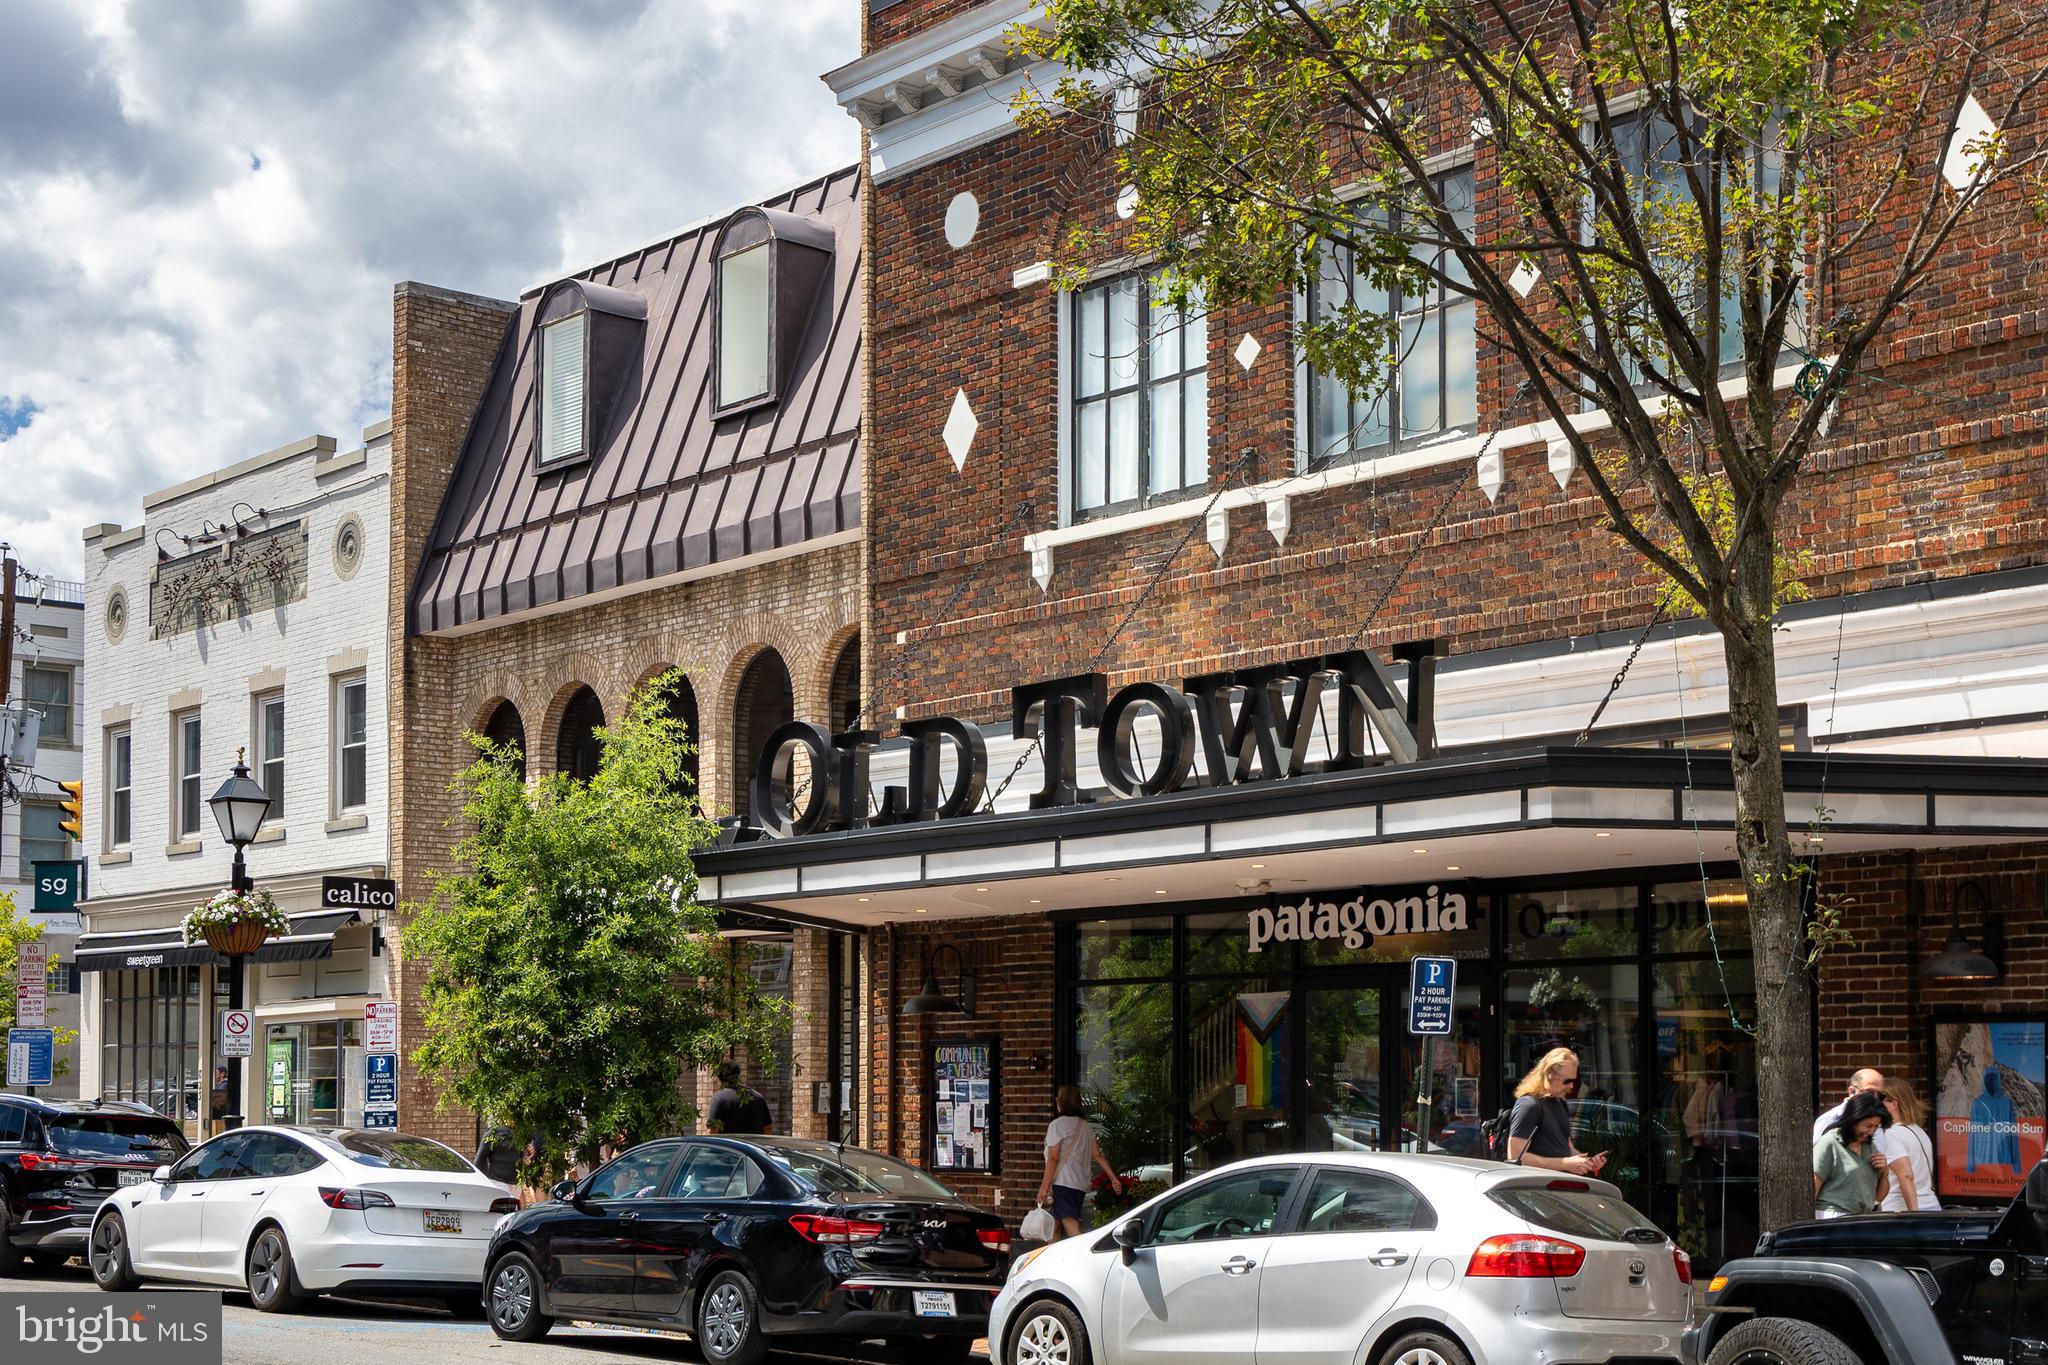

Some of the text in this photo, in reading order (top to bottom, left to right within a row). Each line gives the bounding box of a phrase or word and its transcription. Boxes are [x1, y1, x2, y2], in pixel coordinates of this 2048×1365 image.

[757, 638, 1449, 840] OLD TOWN
[41, 878, 67, 895] sg
[326, 881, 395, 905] calico
[1247, 885, 1468, 953] patagonia
[27, 945, 38, 954] NO
[20, 955, 44, 963] PARKING
[126, 954, 163, 967] sweetgreen
[1427, 963, 1441, 984] P
[1421, 987, 1426, 995] 2
[1427, 996, 1450, 1004] PARKING
[367, 1006, 376, 1016] NO
[935, 1047, 990, 1063] COMMUNITY
[376, 1057, 386, 1071] P
[947, 1062, 983, 1080] EVENTS
[1943, 1121, 2044, 1135] Capilene Cool Sun
[1954, 1174, 1968, 1183] This
[1977, 1176, 1989, 1184] not
[924, 1219, 947, 1228] KIA
[920, 1302, 951, 1310] T2791151
